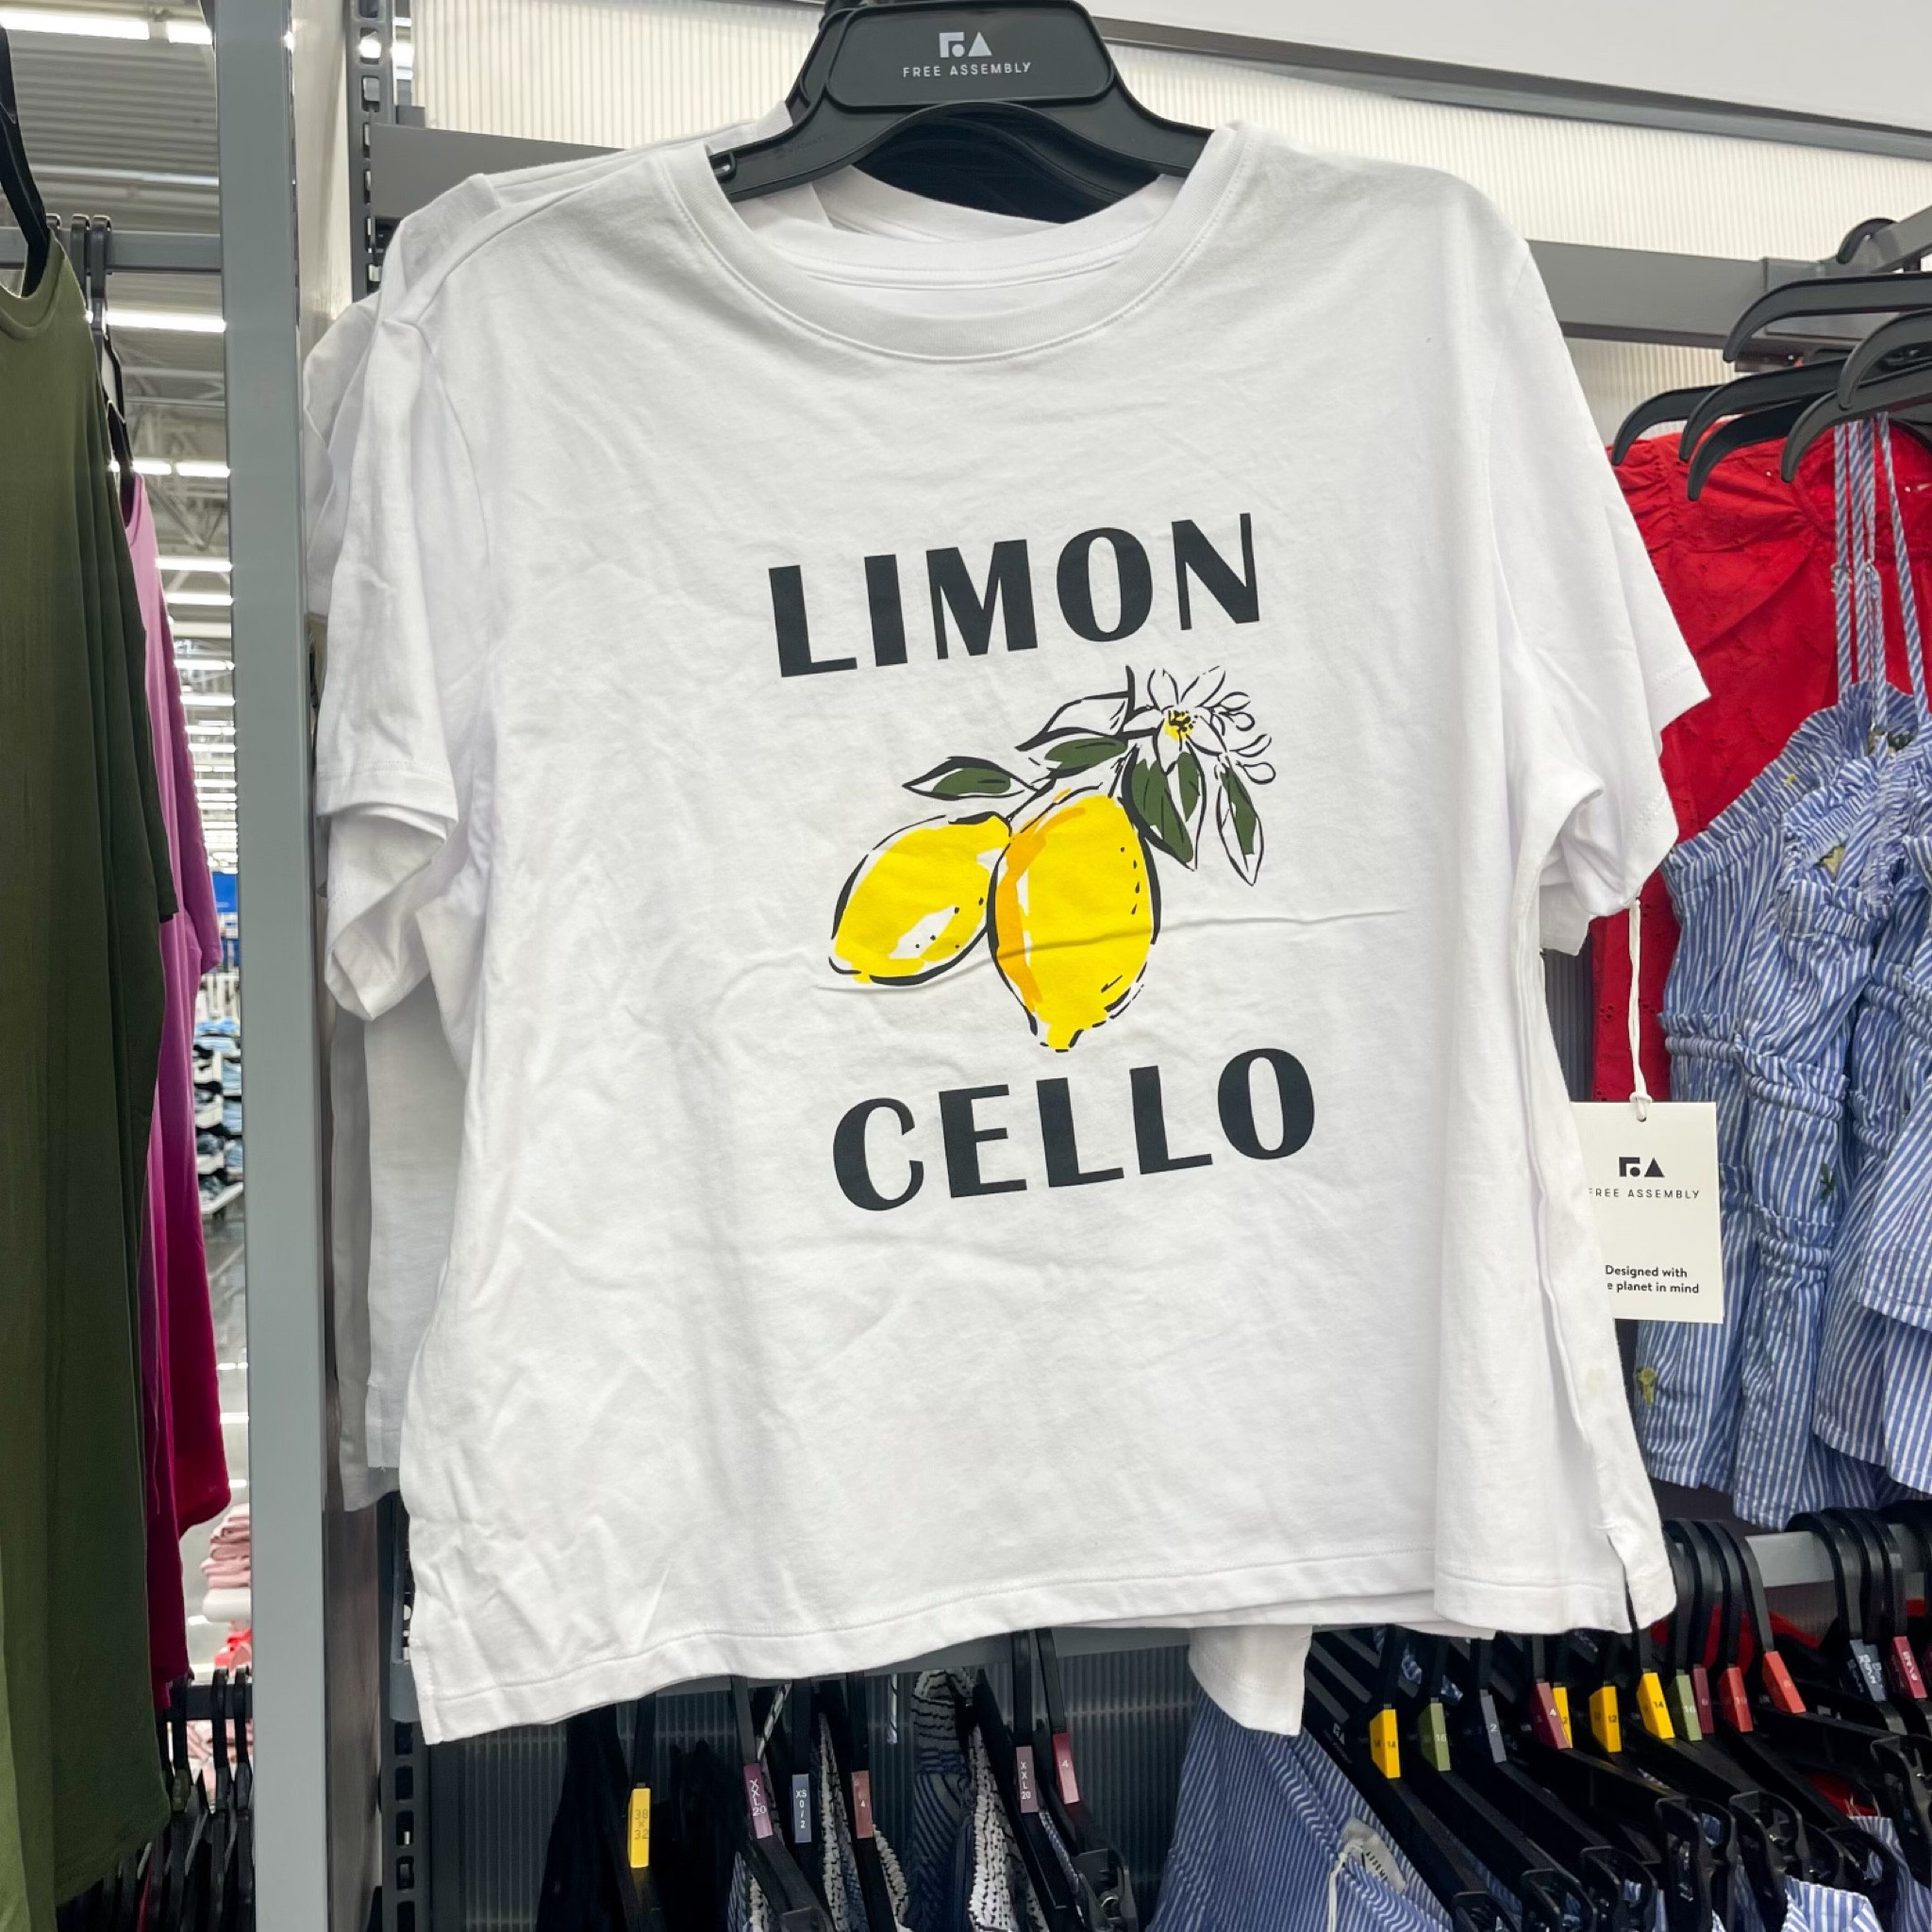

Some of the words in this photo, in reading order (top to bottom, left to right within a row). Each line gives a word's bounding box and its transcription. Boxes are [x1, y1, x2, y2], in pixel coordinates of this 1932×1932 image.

[903, 65, 941, 78] FREE
[949, 61, 1031, 76] ASSEMBLY
[768, 512, 1260, 678] LIMON
[832, 1047, 1315, 1211] CELLO
[1627, 1189, 1700, 1199] ASSEMBLY
[1605, 1264, 1658, 1278] Designed
[1662, 1267, 1688, 1277] with
[1616, 1280, 1652, 1293] planet
[1656, 1282, 1667, 1292] in
[1669, 1283, 1699, 1293] mind
[1489, 1724, 1498, 1732] 2
[1061, 1759, 1069, 1768] 4
[1021, 1790, 1032, 1800] 20
[752, 1805, 767, 1817] 20
[634, 1828, 649, 1840] 32
